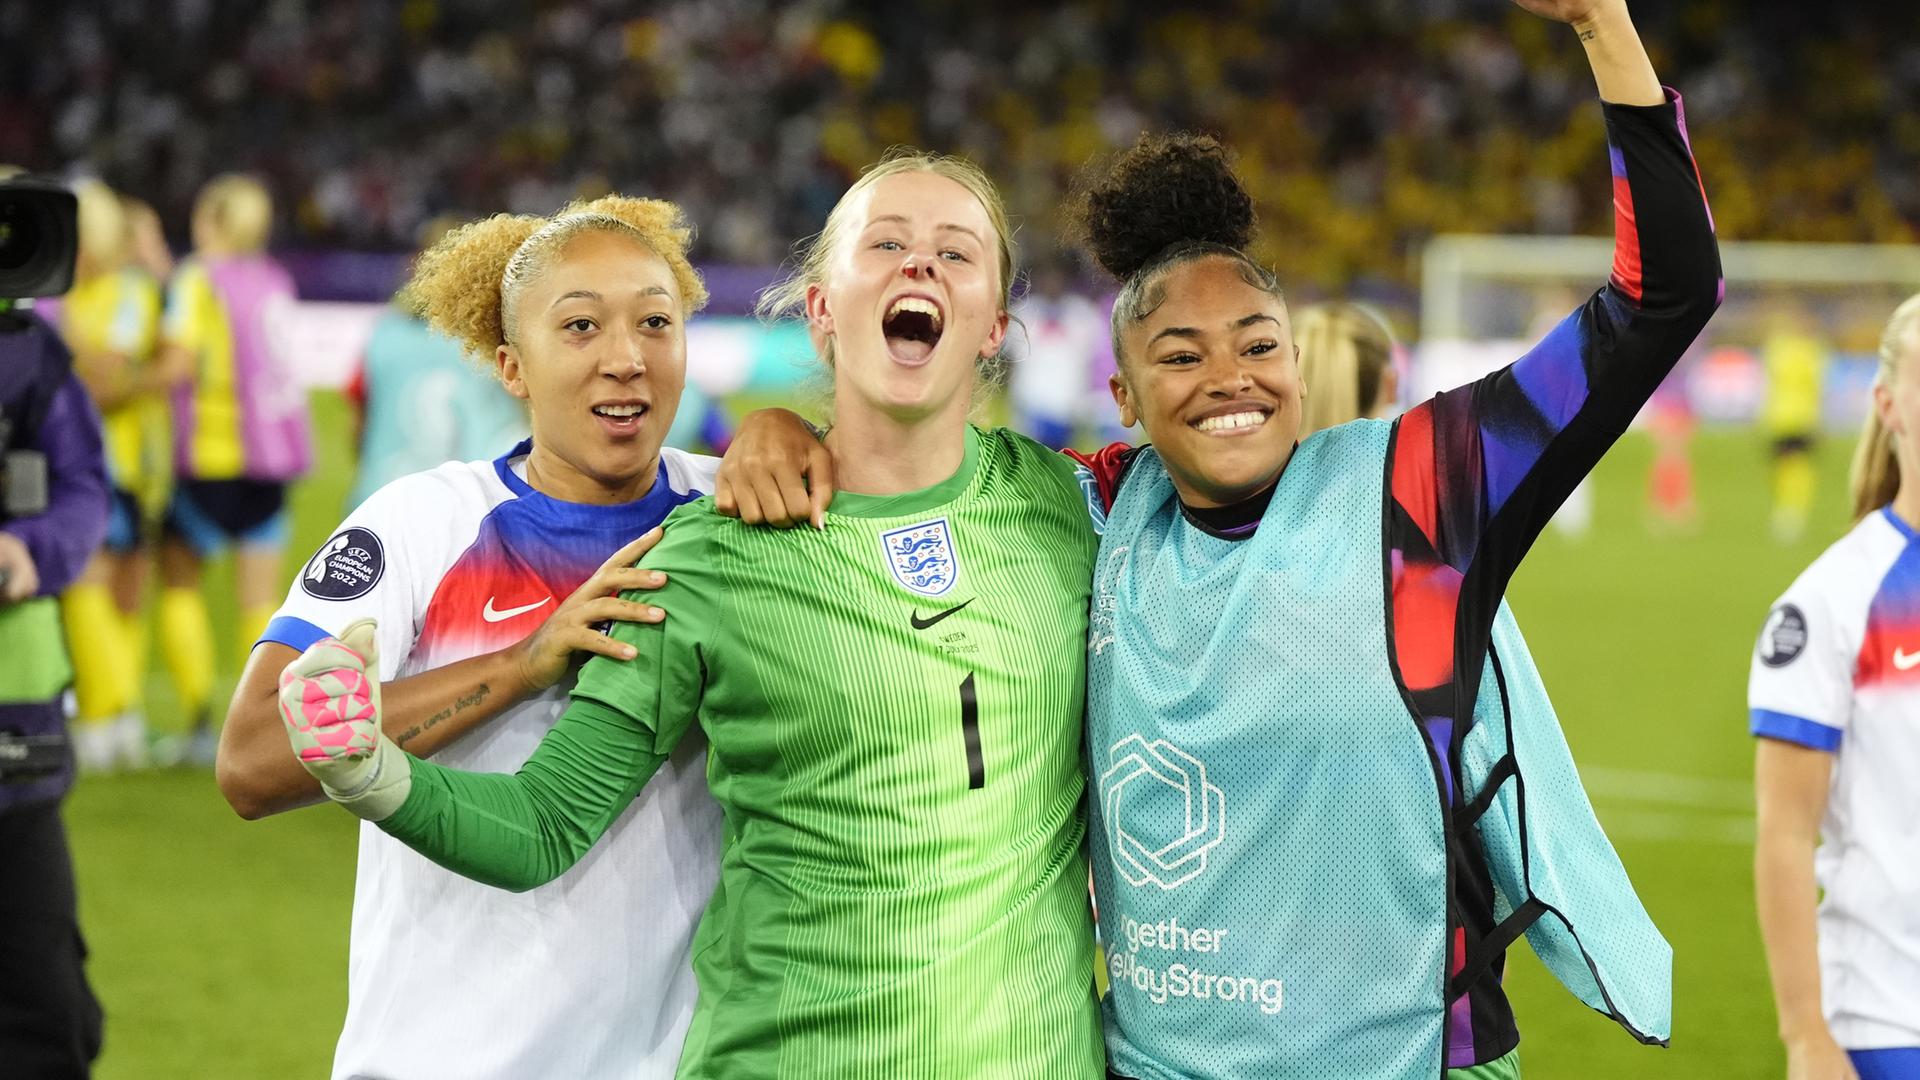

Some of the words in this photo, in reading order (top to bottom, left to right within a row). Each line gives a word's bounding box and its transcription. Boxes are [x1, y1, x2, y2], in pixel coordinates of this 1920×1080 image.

[334, 555, 374, 575] EUROPEAN
[347, 549, 371, 562] UEFA
[329, 561, 372, 583] CHAMPIONS
[330, 570, 358, 587] 2022
[959, 670, 985, 790] 1
[1121, 914, 1228, 954] gether
